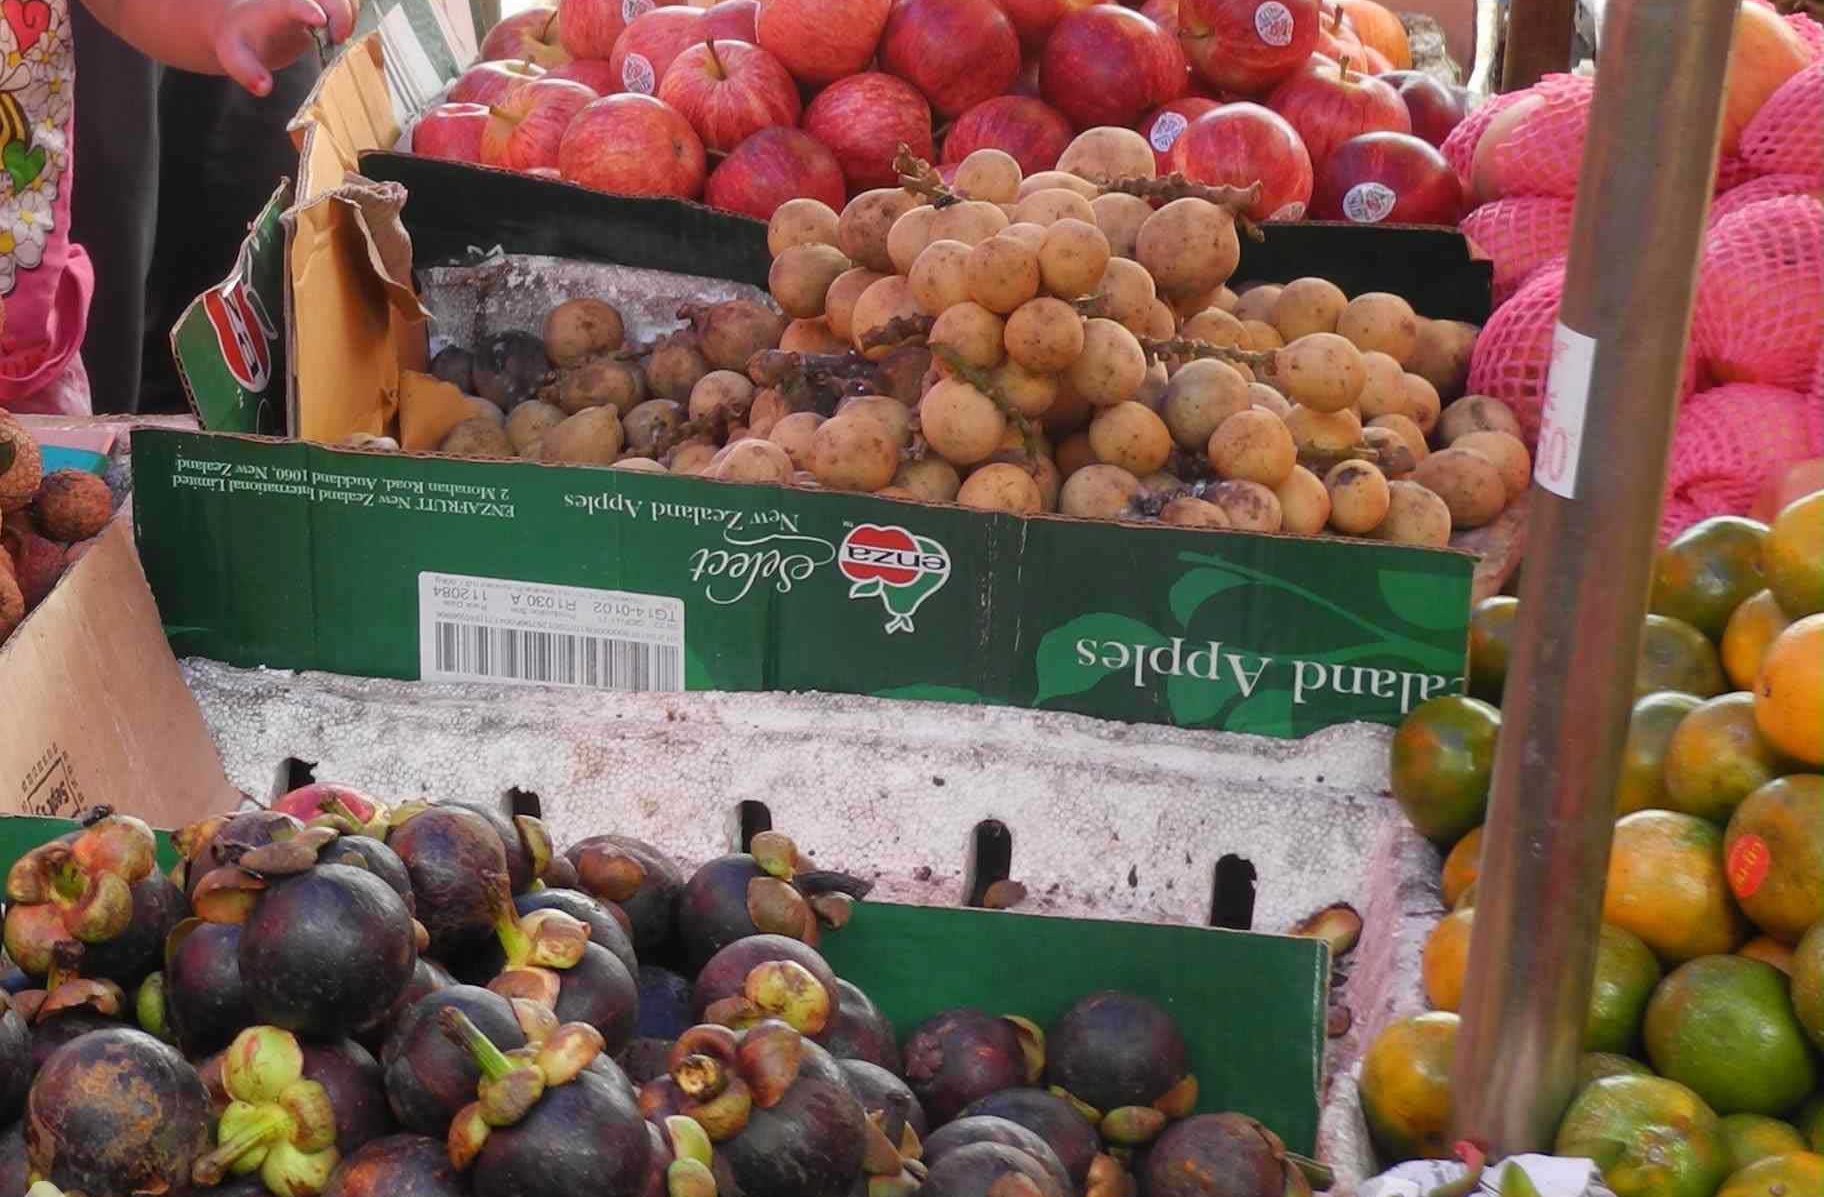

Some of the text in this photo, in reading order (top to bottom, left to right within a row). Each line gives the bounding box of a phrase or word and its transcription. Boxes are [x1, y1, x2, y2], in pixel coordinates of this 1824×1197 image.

[177, 458, 232, 475] Zealand
[236, 464, 268, 479] New
[312, 472, 377, 491] Auckland
[428, 481, 496, 497] Monahan
[173, 474, 515, 518] ENZAFRUIT New Zealand International Limited
[501, 487, 509, 500] 2
[563, 493, 800, 532] New Zealand Apples
[847, 545, 946, 571] enza
[689, 532, 835, 603] Select
[433, 586, 489, 601] 112084
[510, 594, 521, 605] A
[1075, 637, 1273, 698] Apples
